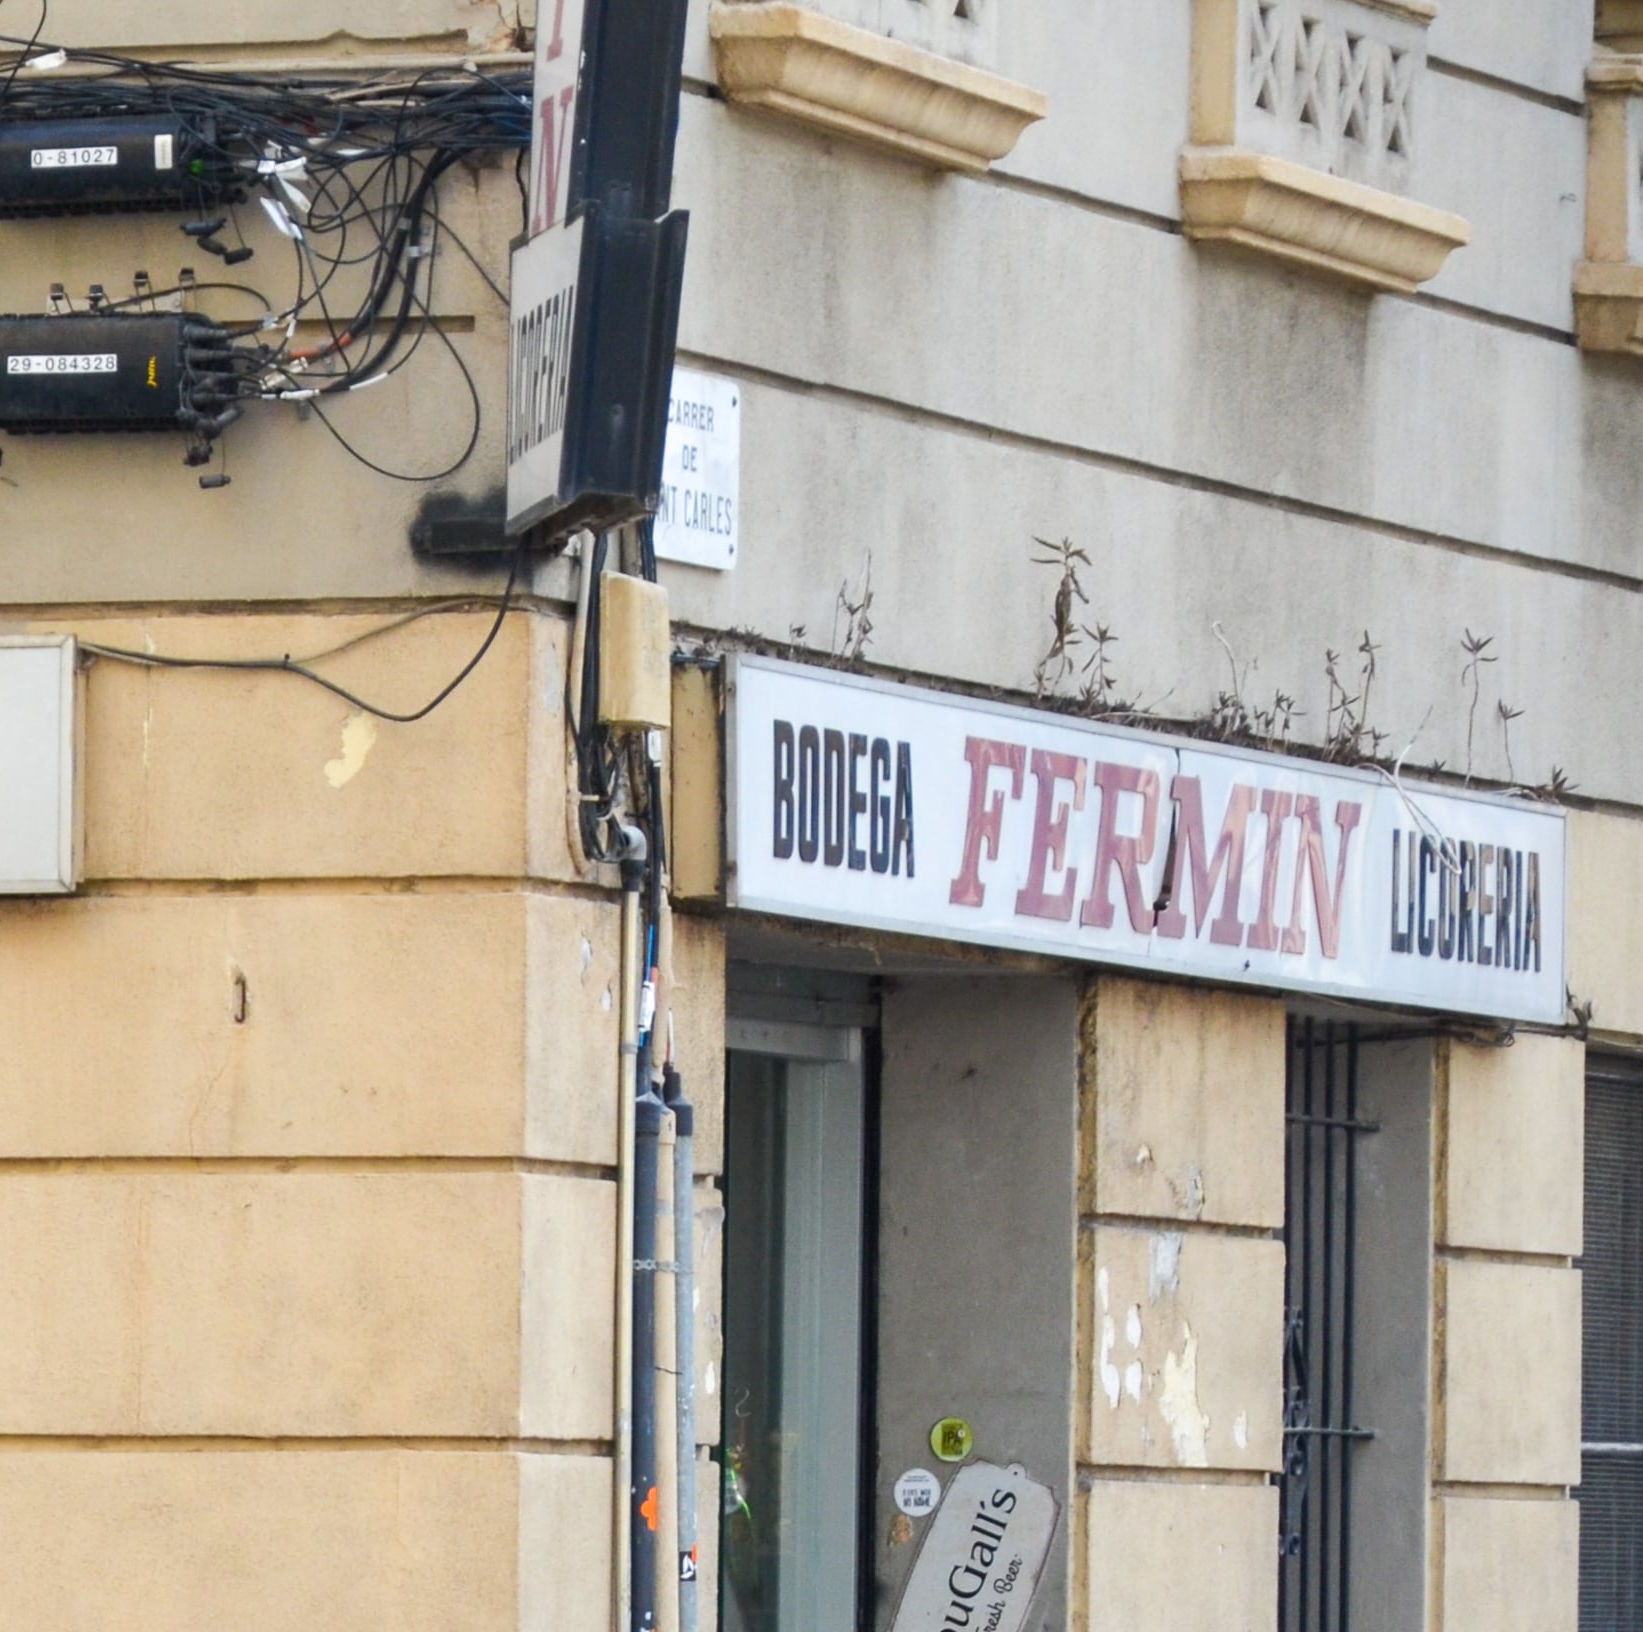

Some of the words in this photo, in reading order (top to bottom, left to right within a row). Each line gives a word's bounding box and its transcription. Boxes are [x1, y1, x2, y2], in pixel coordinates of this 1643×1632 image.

[33, 148, 115, 166] 0-81027
[9, 355, 116, 371] 29-084328
[682, 443, 698, 472] DE
[683, 488, 732, 536] CARLES
[772, 719, 916, 879] BODEGA
[948, 735, 1362, 959] FERMIN
[1390, 828, 1542, 973] LICORERIA
